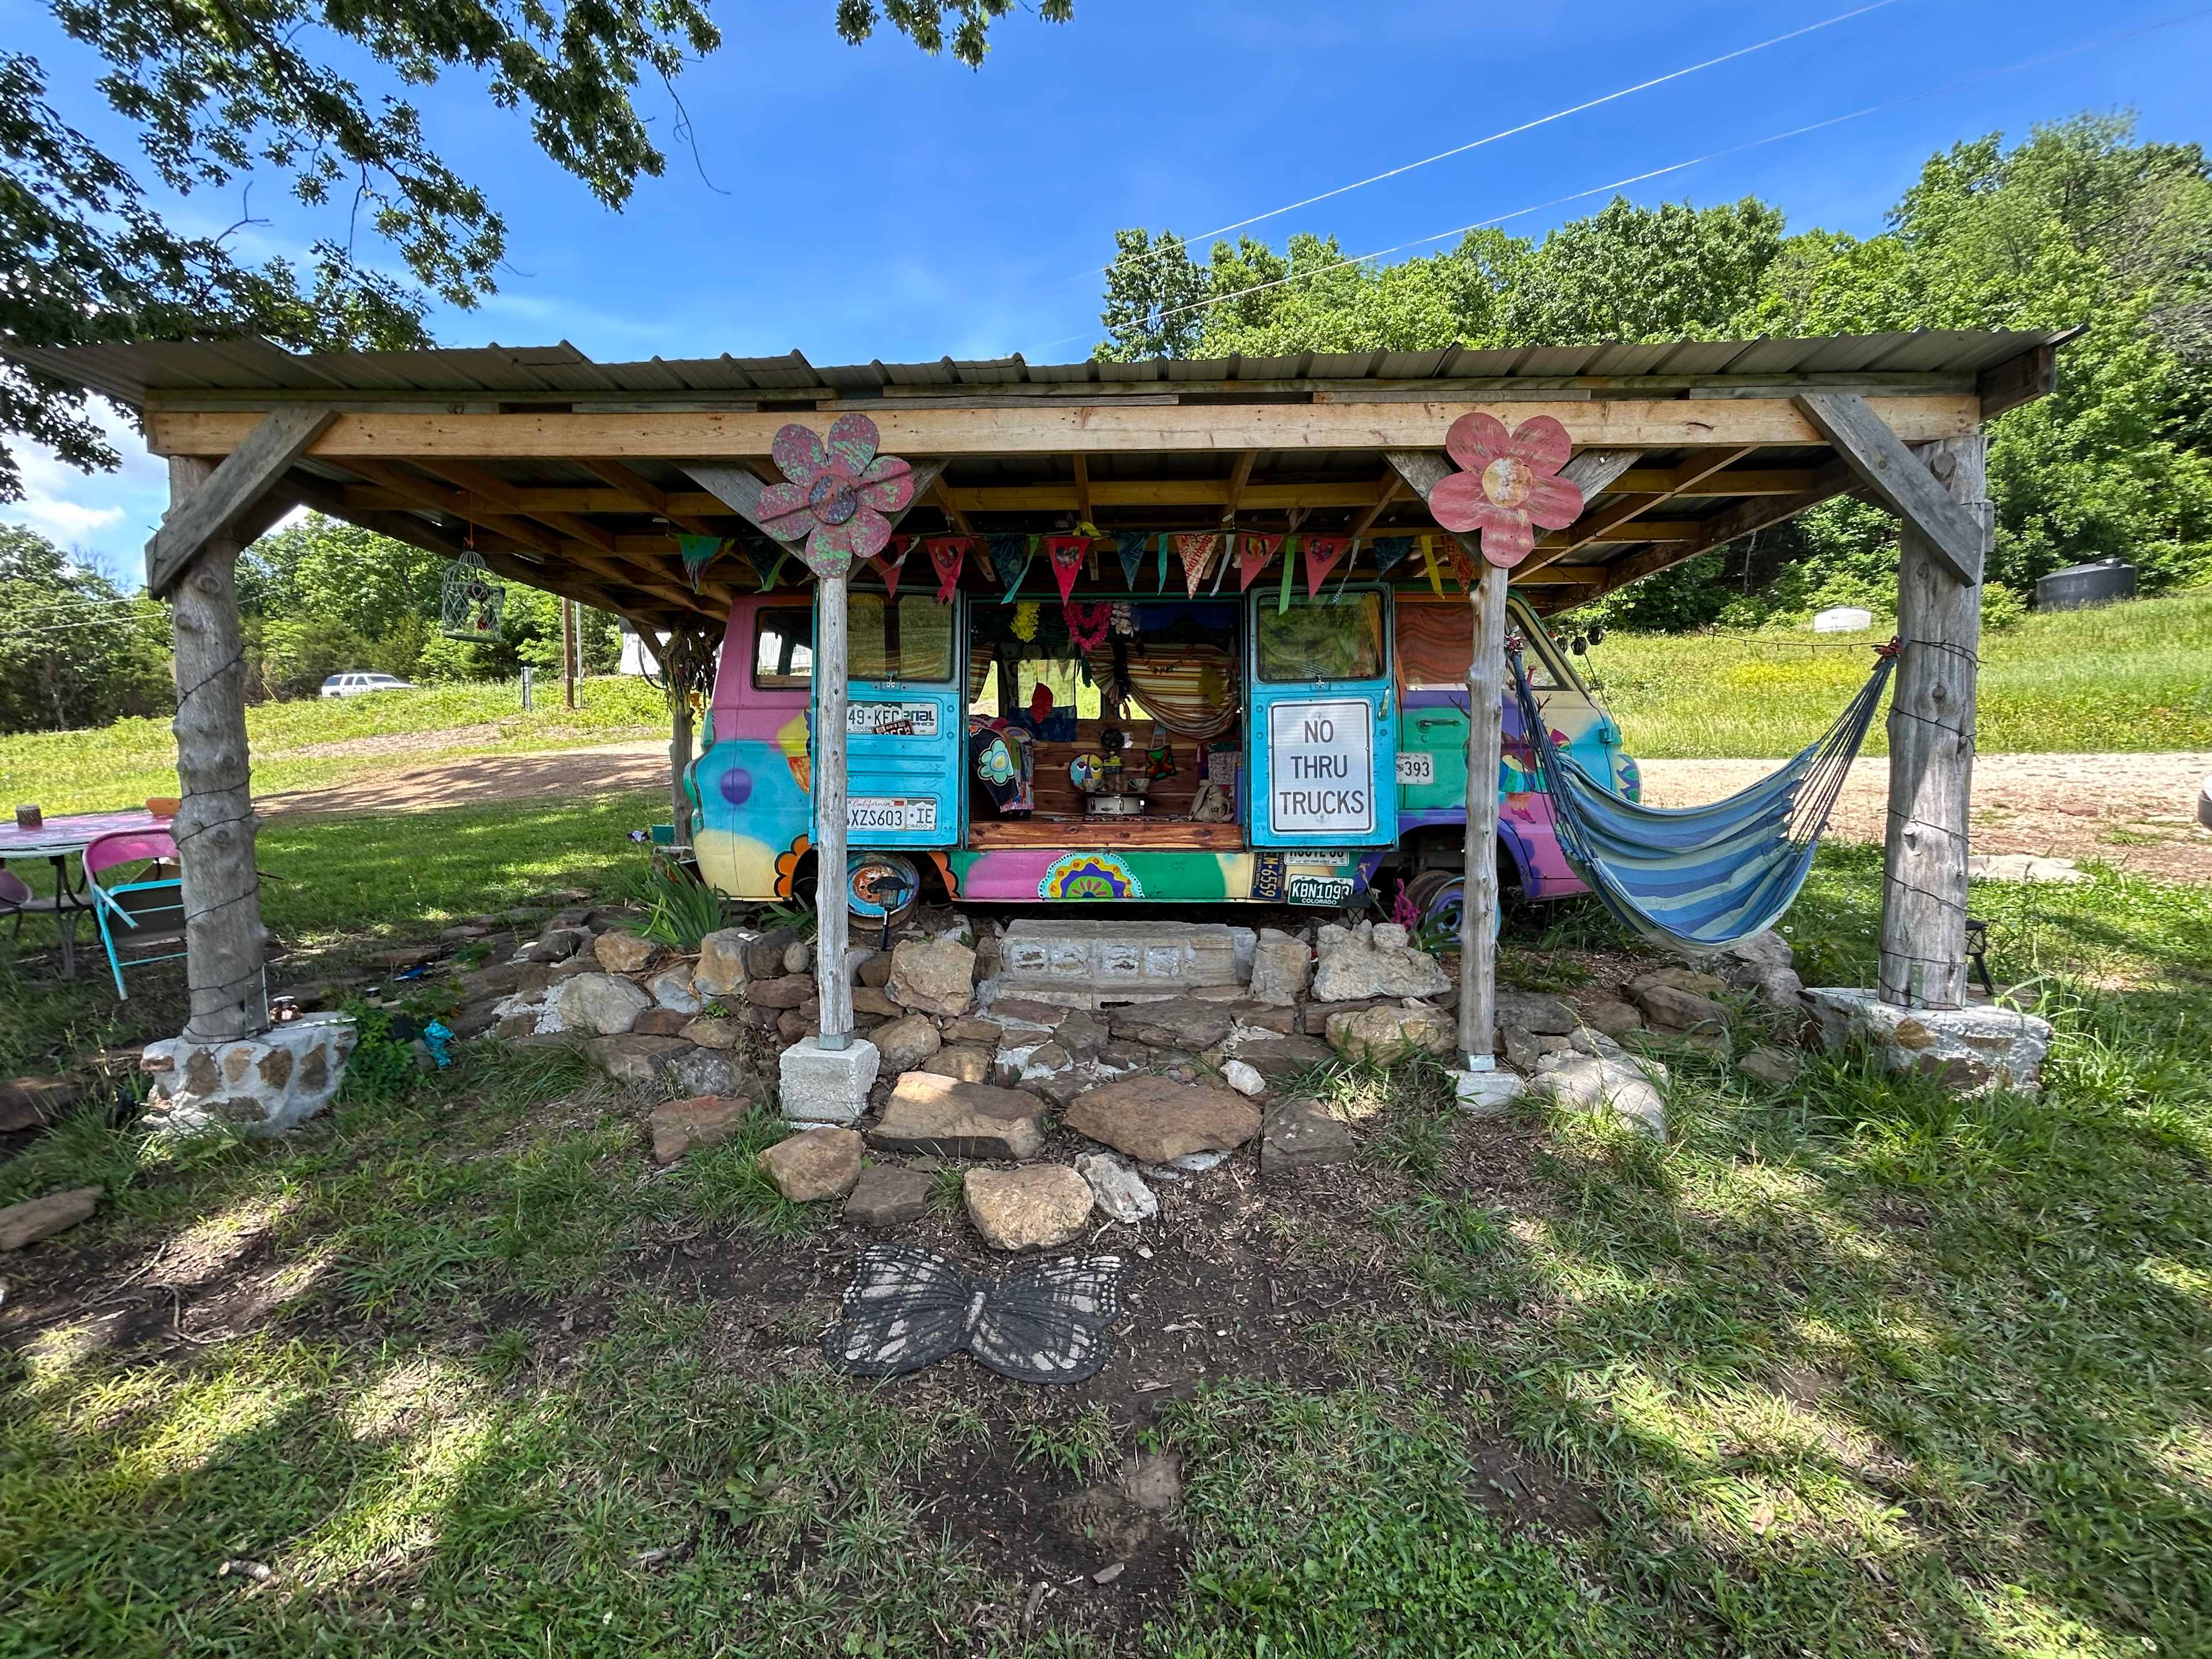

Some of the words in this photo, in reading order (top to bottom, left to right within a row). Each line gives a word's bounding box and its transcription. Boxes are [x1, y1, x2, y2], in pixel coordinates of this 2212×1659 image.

[1304, 720, 1334, 743] NO
[1290, 755, 1347, 779] THRU
[1404, 762, 1429, 777] 393
[853, 799, 890, 809] California
[1279, 790, 1364, 815] TRUCKS
